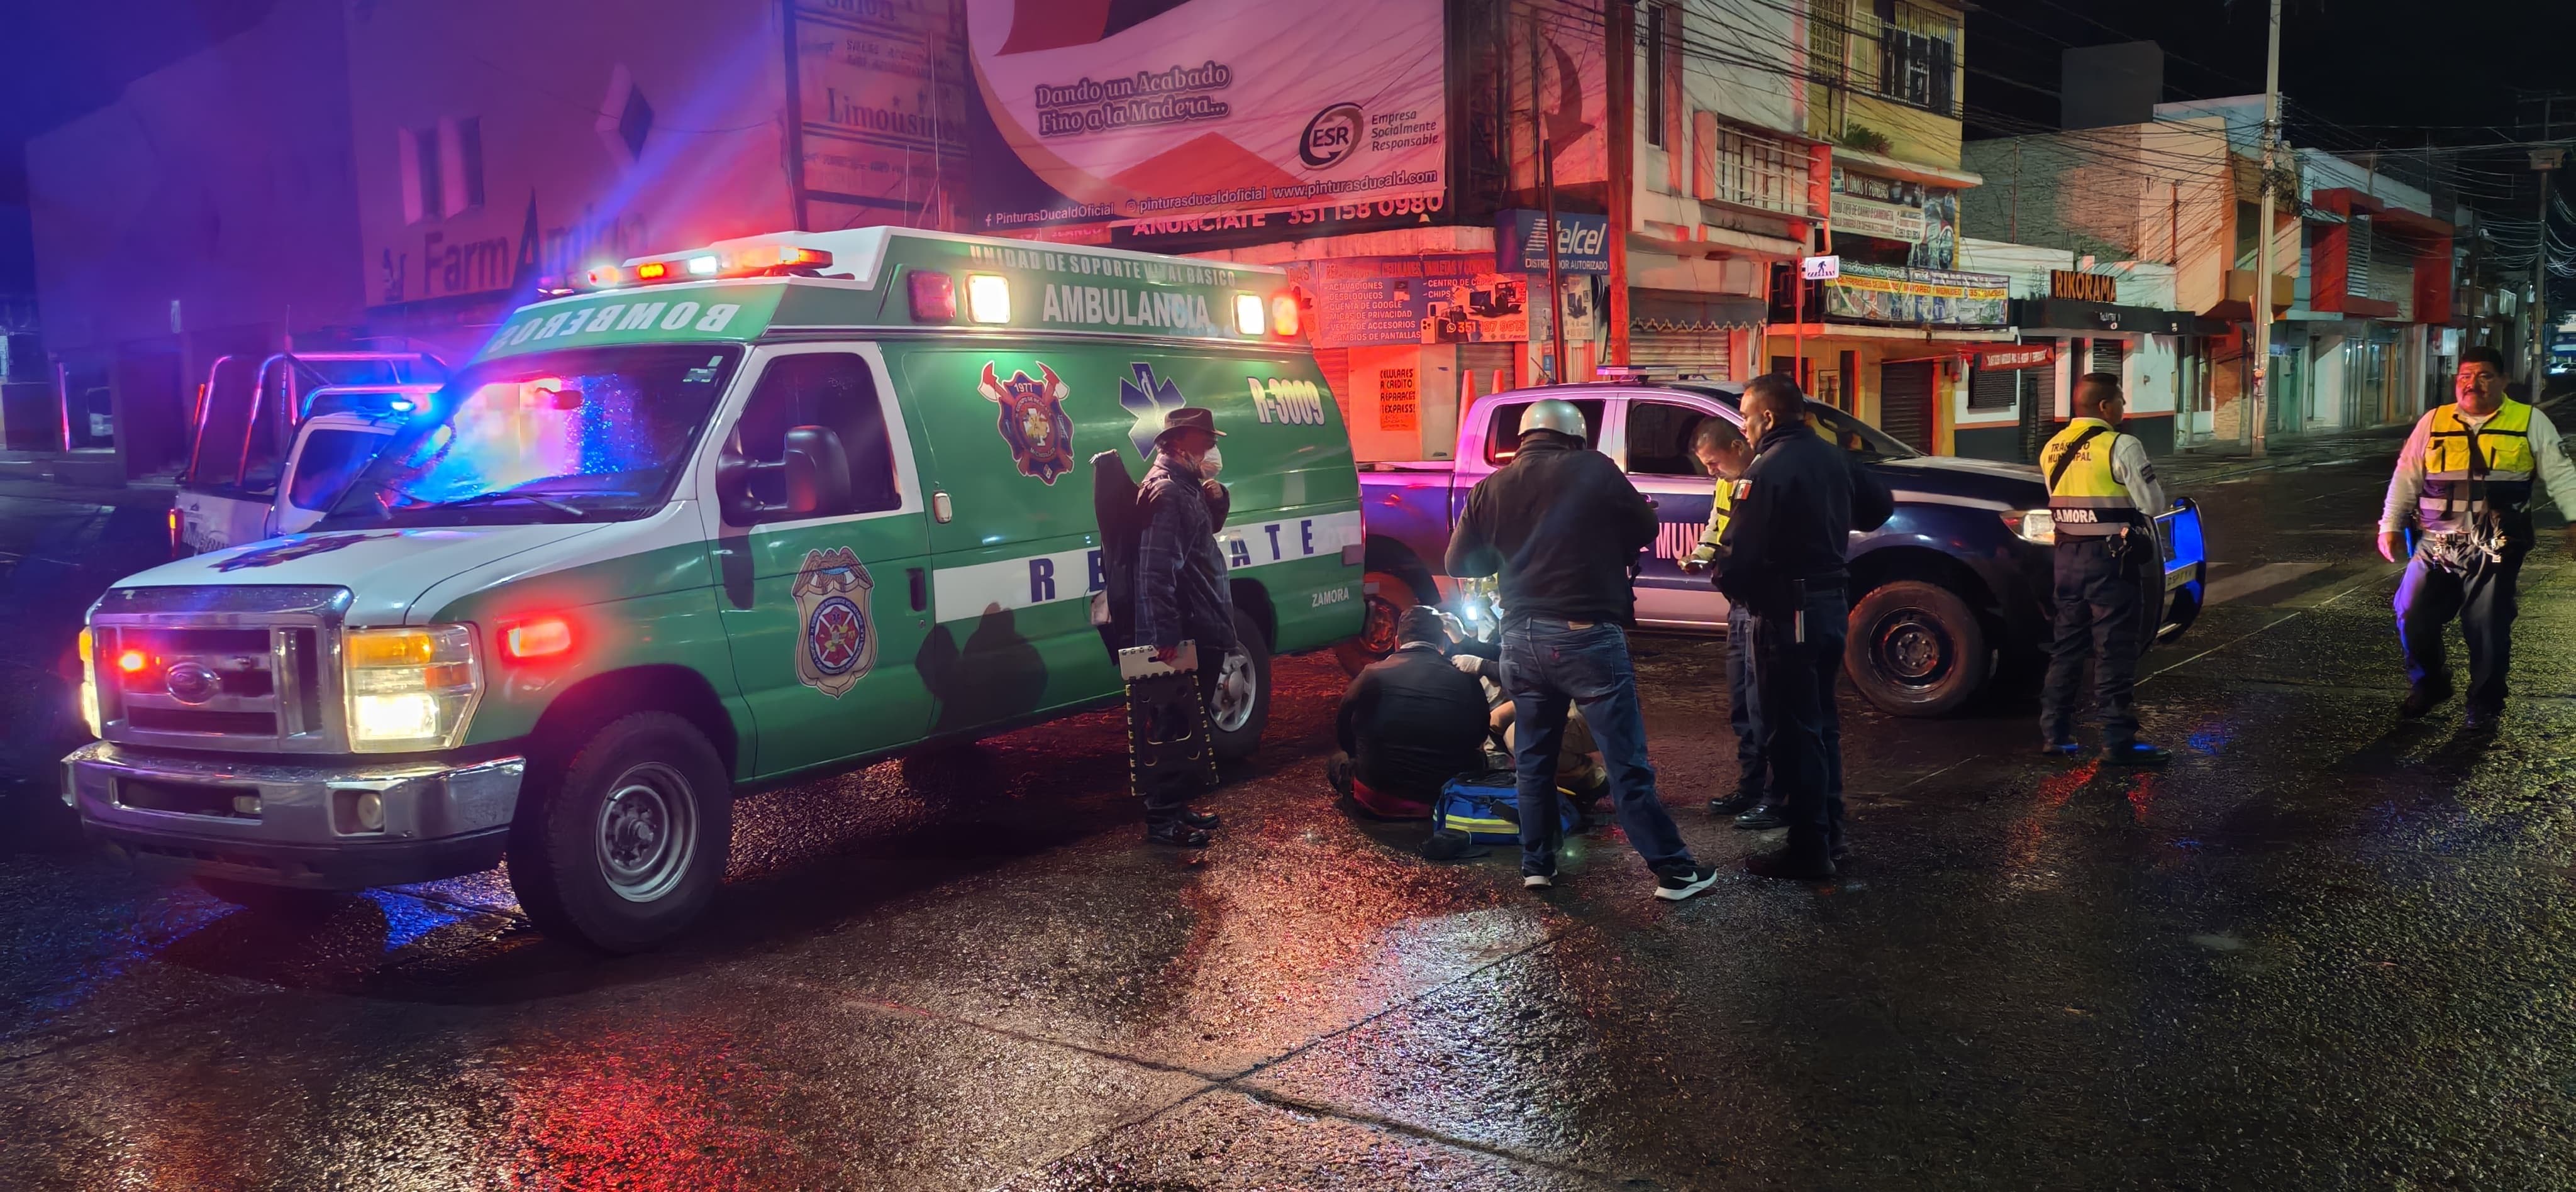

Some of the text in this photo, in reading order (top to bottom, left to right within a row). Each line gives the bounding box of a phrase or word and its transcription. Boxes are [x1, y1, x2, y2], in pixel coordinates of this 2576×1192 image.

[1038, 64, 1227, 106] Dando un Acabado
[1041, 97, 1225, 132] Fino a la Madera...
[1371, 110, 1417, 126] Empresa
[1313, 126, 1349, 147] ESR
[1371, 121, 1437, 138] Socialmente
[1372, 133, 1439, 152] Responsable
[1139, 170, 1438, 214] pinturasducaldoficial www.pinturasducald.com
[996, 202, 1114, 224] PinturasDucaldOficial
[1556, 220, 1607, 255] elcel
[970, 245, 1040, 270] UNIDAD
[1045, 253, 1066, 272] DE
[1070, 257, 1141, 279] SOPORTE
[1571, 260, 1607, 270] AUTORIZADO
[2055, 270, 2116, 302] RIKORAMA
[1043, 284, 1211, 329] AMBULANCIA
[1357, 311, 1366, 319] DE
[1368, 310, 1412, 318] PRIVACIDAD
[1360, 301, 1370, 309] DE
[1372, 300, 1402, 309] GOOGLE
[1368, 321, 1416, 329] ACCESORIOS
[1458, 322, 1476, 333] 351
[1380, 331, 1421, 340] PANTALLAS
[1380, 368, 1413, 378] CELULARES
[1014, 382, 1033, 393] 1977
[1247, 377, 1324, 425] R-3009
[1312, 587, 1349, 608] ZAMORA
